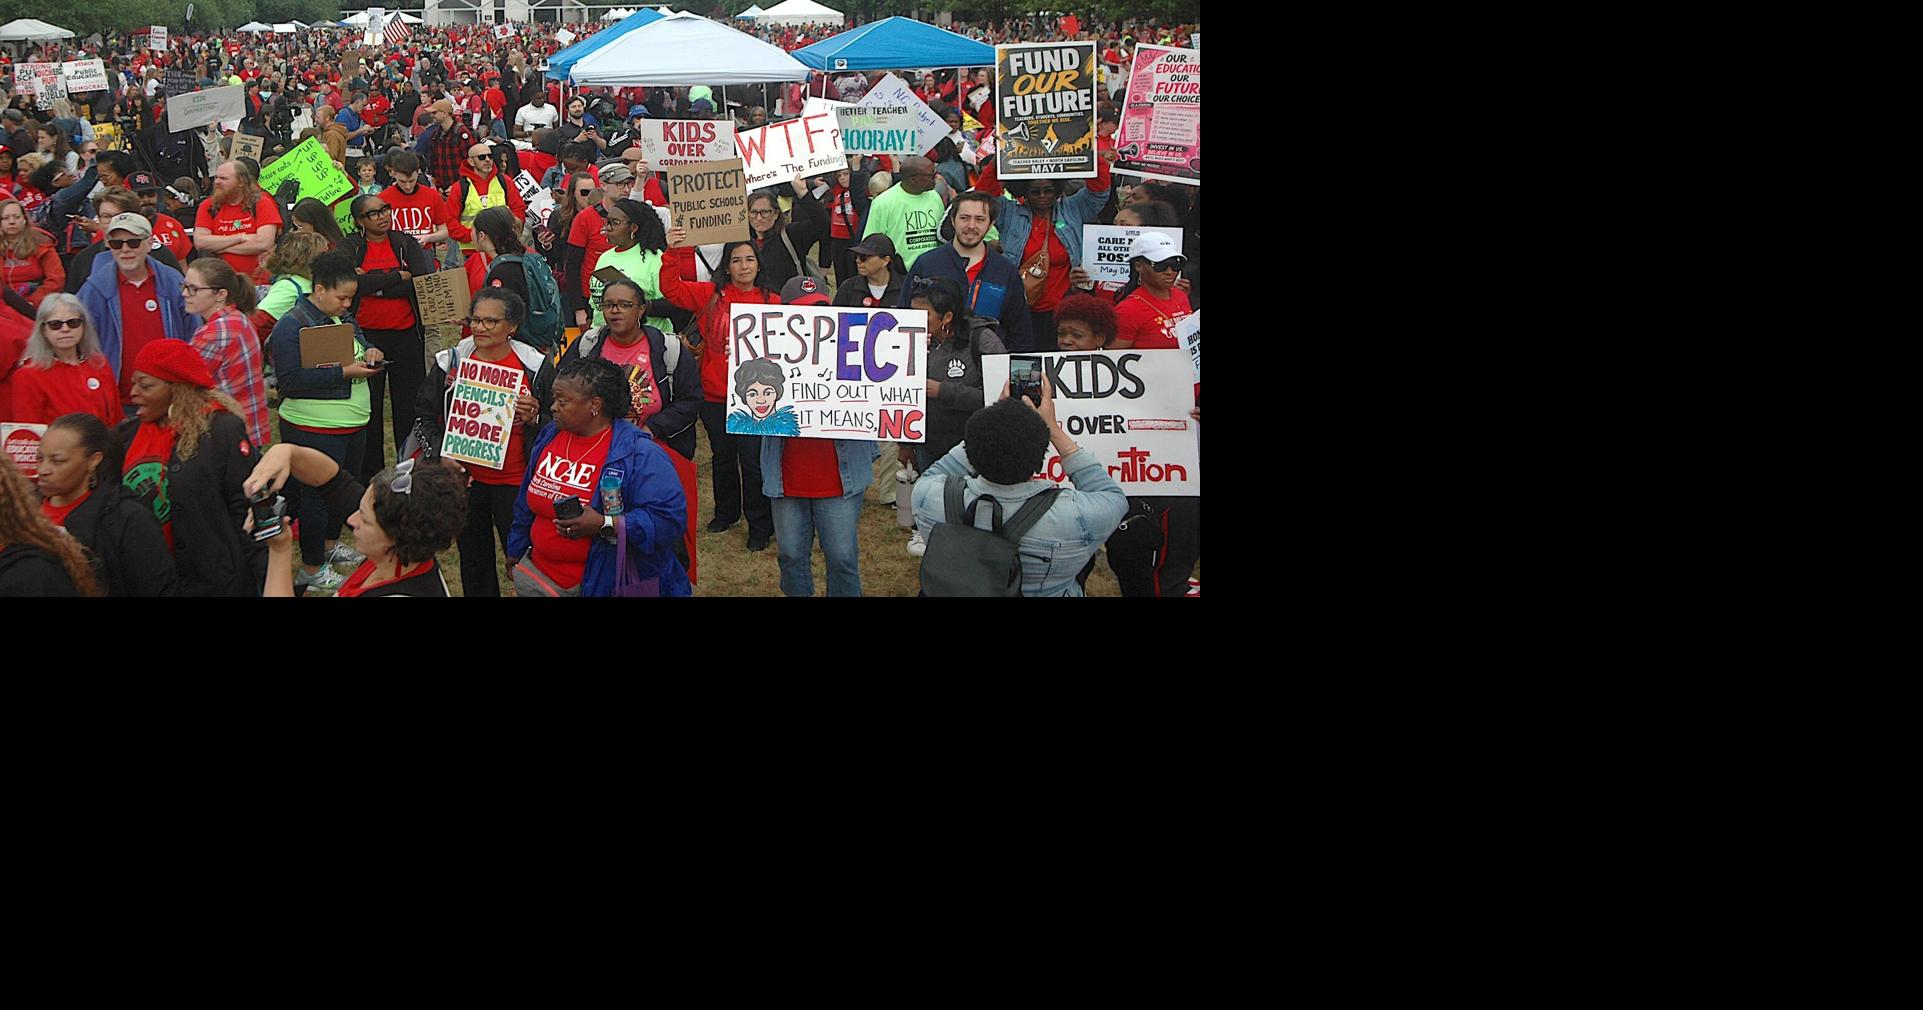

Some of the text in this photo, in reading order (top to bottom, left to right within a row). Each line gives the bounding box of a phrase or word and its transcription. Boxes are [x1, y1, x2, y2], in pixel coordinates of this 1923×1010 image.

[1009, 48, 1080, 76] FUND
[1166, 55, 1187, 63] OUR
[1013, 70, 1079, 96] OUR
[1156, 82, 1200, 94] FUTUR
[873, 106, 908, 115] TEACHER
[1003, 89, 1092, 118] FUTURE
[663, 122, 716, 143] KIDS
[841, 129, 917, 151] HOORAY!
[302, 140, 314, 153] UP
[667, 143, 706, 156] OVER
[306, 152, 318, 163] UP
[312, 160, 323, 173] UP
[316, 167, 329, 181] UP
[781, 163, 805, 174] The
[1031, 165, 1056, 173] MAY
[670, 169, 743, 194] PROTECT
[672, 195, 744, 213] PUBLIC SCHOOLS
[391, 206, 432, 231] KIDS
[690, 213, 732, 229] FUNDING
[905, 210, 937, 230] KIDS
[1098, 237, 1126, 245] CARE
[1100, 266, 1118, 277] May
[424, 275, 434, 294] KIDS
[460, 361, 518, 389] NO MORE
[1045, 353, 1145, 399] KIDS
[455, 384, 507, 407] PENCILS
[792, 382, 923, 404] FIND OUT WHAT
[452, 399, 481, 418] NO
[448, 416, 502, 443] MORE
[800, 409, 924, 439] IT MEANS, NC
[1067, 415, 1126, 435] OVER
[444, 434, 503, 462] PROGRESS
[537, 452, 596, 487] NCAE
